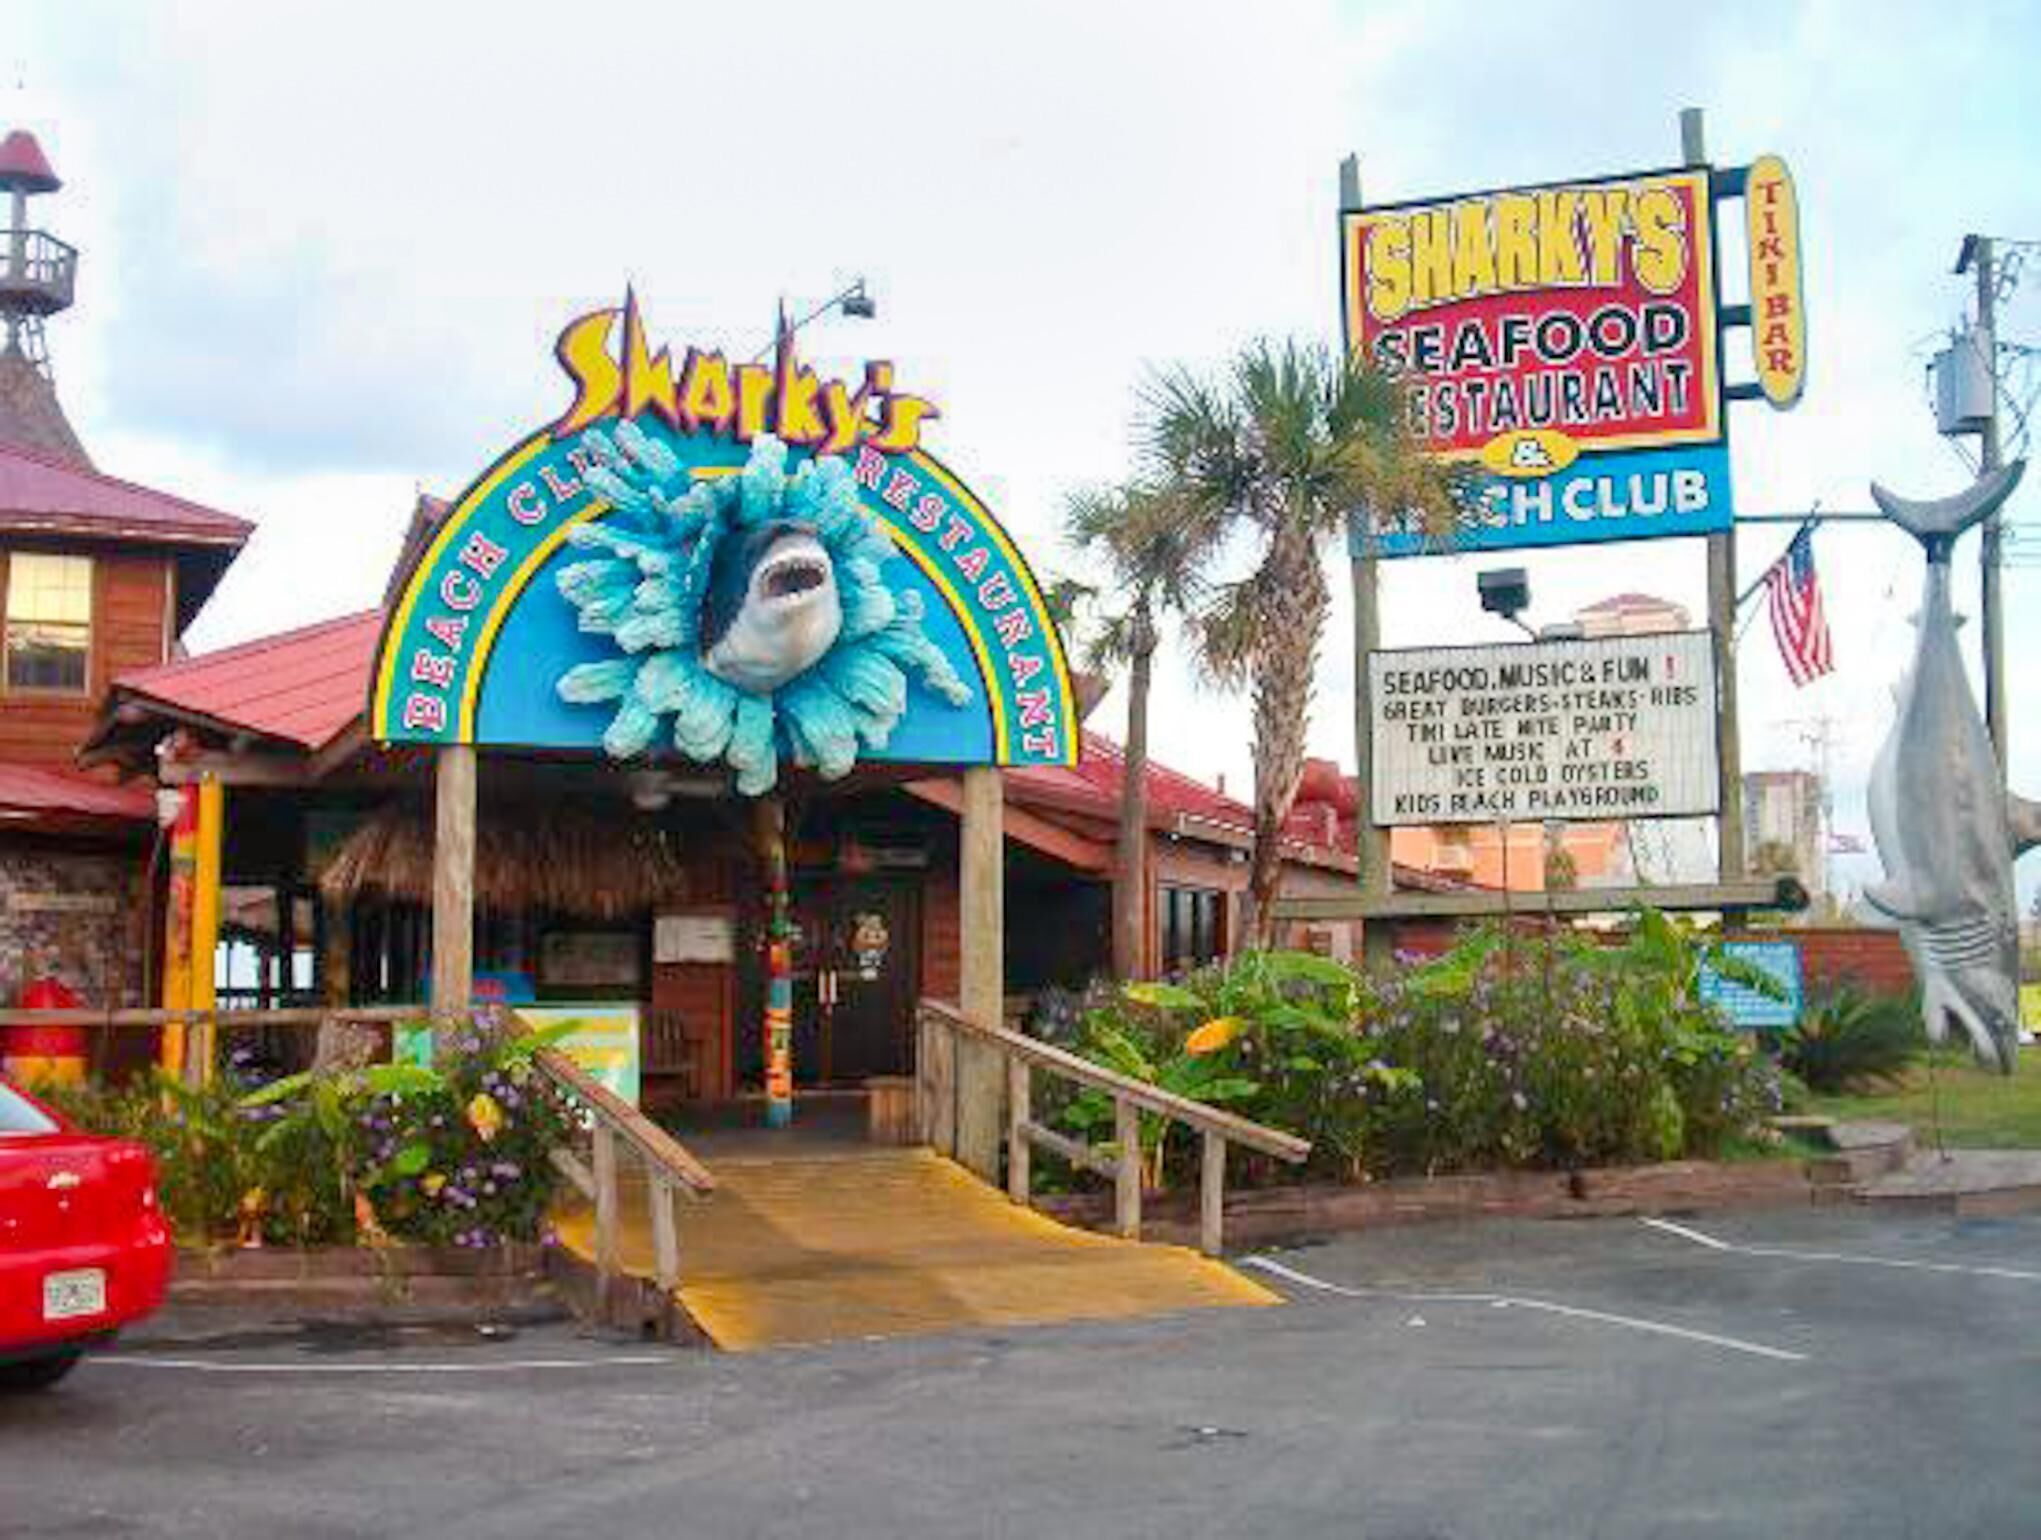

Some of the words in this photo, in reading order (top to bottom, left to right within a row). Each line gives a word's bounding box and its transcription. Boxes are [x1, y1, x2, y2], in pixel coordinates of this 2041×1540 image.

[1366, 187, 1689, 322] SHARKY'S
[1757, 181, 1784, 285] TIKI
[1373, 303, 1690, 379] SEAFOOD
[1764, 294, 1796, 374] BAR
[554, 282, 941, 454] Sharky's
[1405, 360, 1693, 440] ESTAURANT
[1511, 436, 1553, 468] &
[1563, 469, 1709, 520] CLUB
[404, 530, 508, 730] BEACH
[853, 446, 1058, 758] RESTAURANT
[1602, 656, 1649, 684] FUN
[1383, 700, 1447, 721] GREAT
[1454, 720, 1503, 740] LATE
[1517, 717, 1559, 736] NITE
[1573, 712, 1637, 734] PARTY
[1428, 745, 1474, 765] LIVE
[1484, 741, 1545, 762] MUSIC
[1565, 738, 1592, 759] AT
[1457, 767, 1485, 787] ICE
[1496, 764, 1548, 786] COLD
[1561, 760, 1649, 784] OYSTERS
[1394, 793, 1441, 814] KIDS
[1450, 790, 1516, 813] BEACH
[1528, 786, 1659, 809] PLAYGROUND
